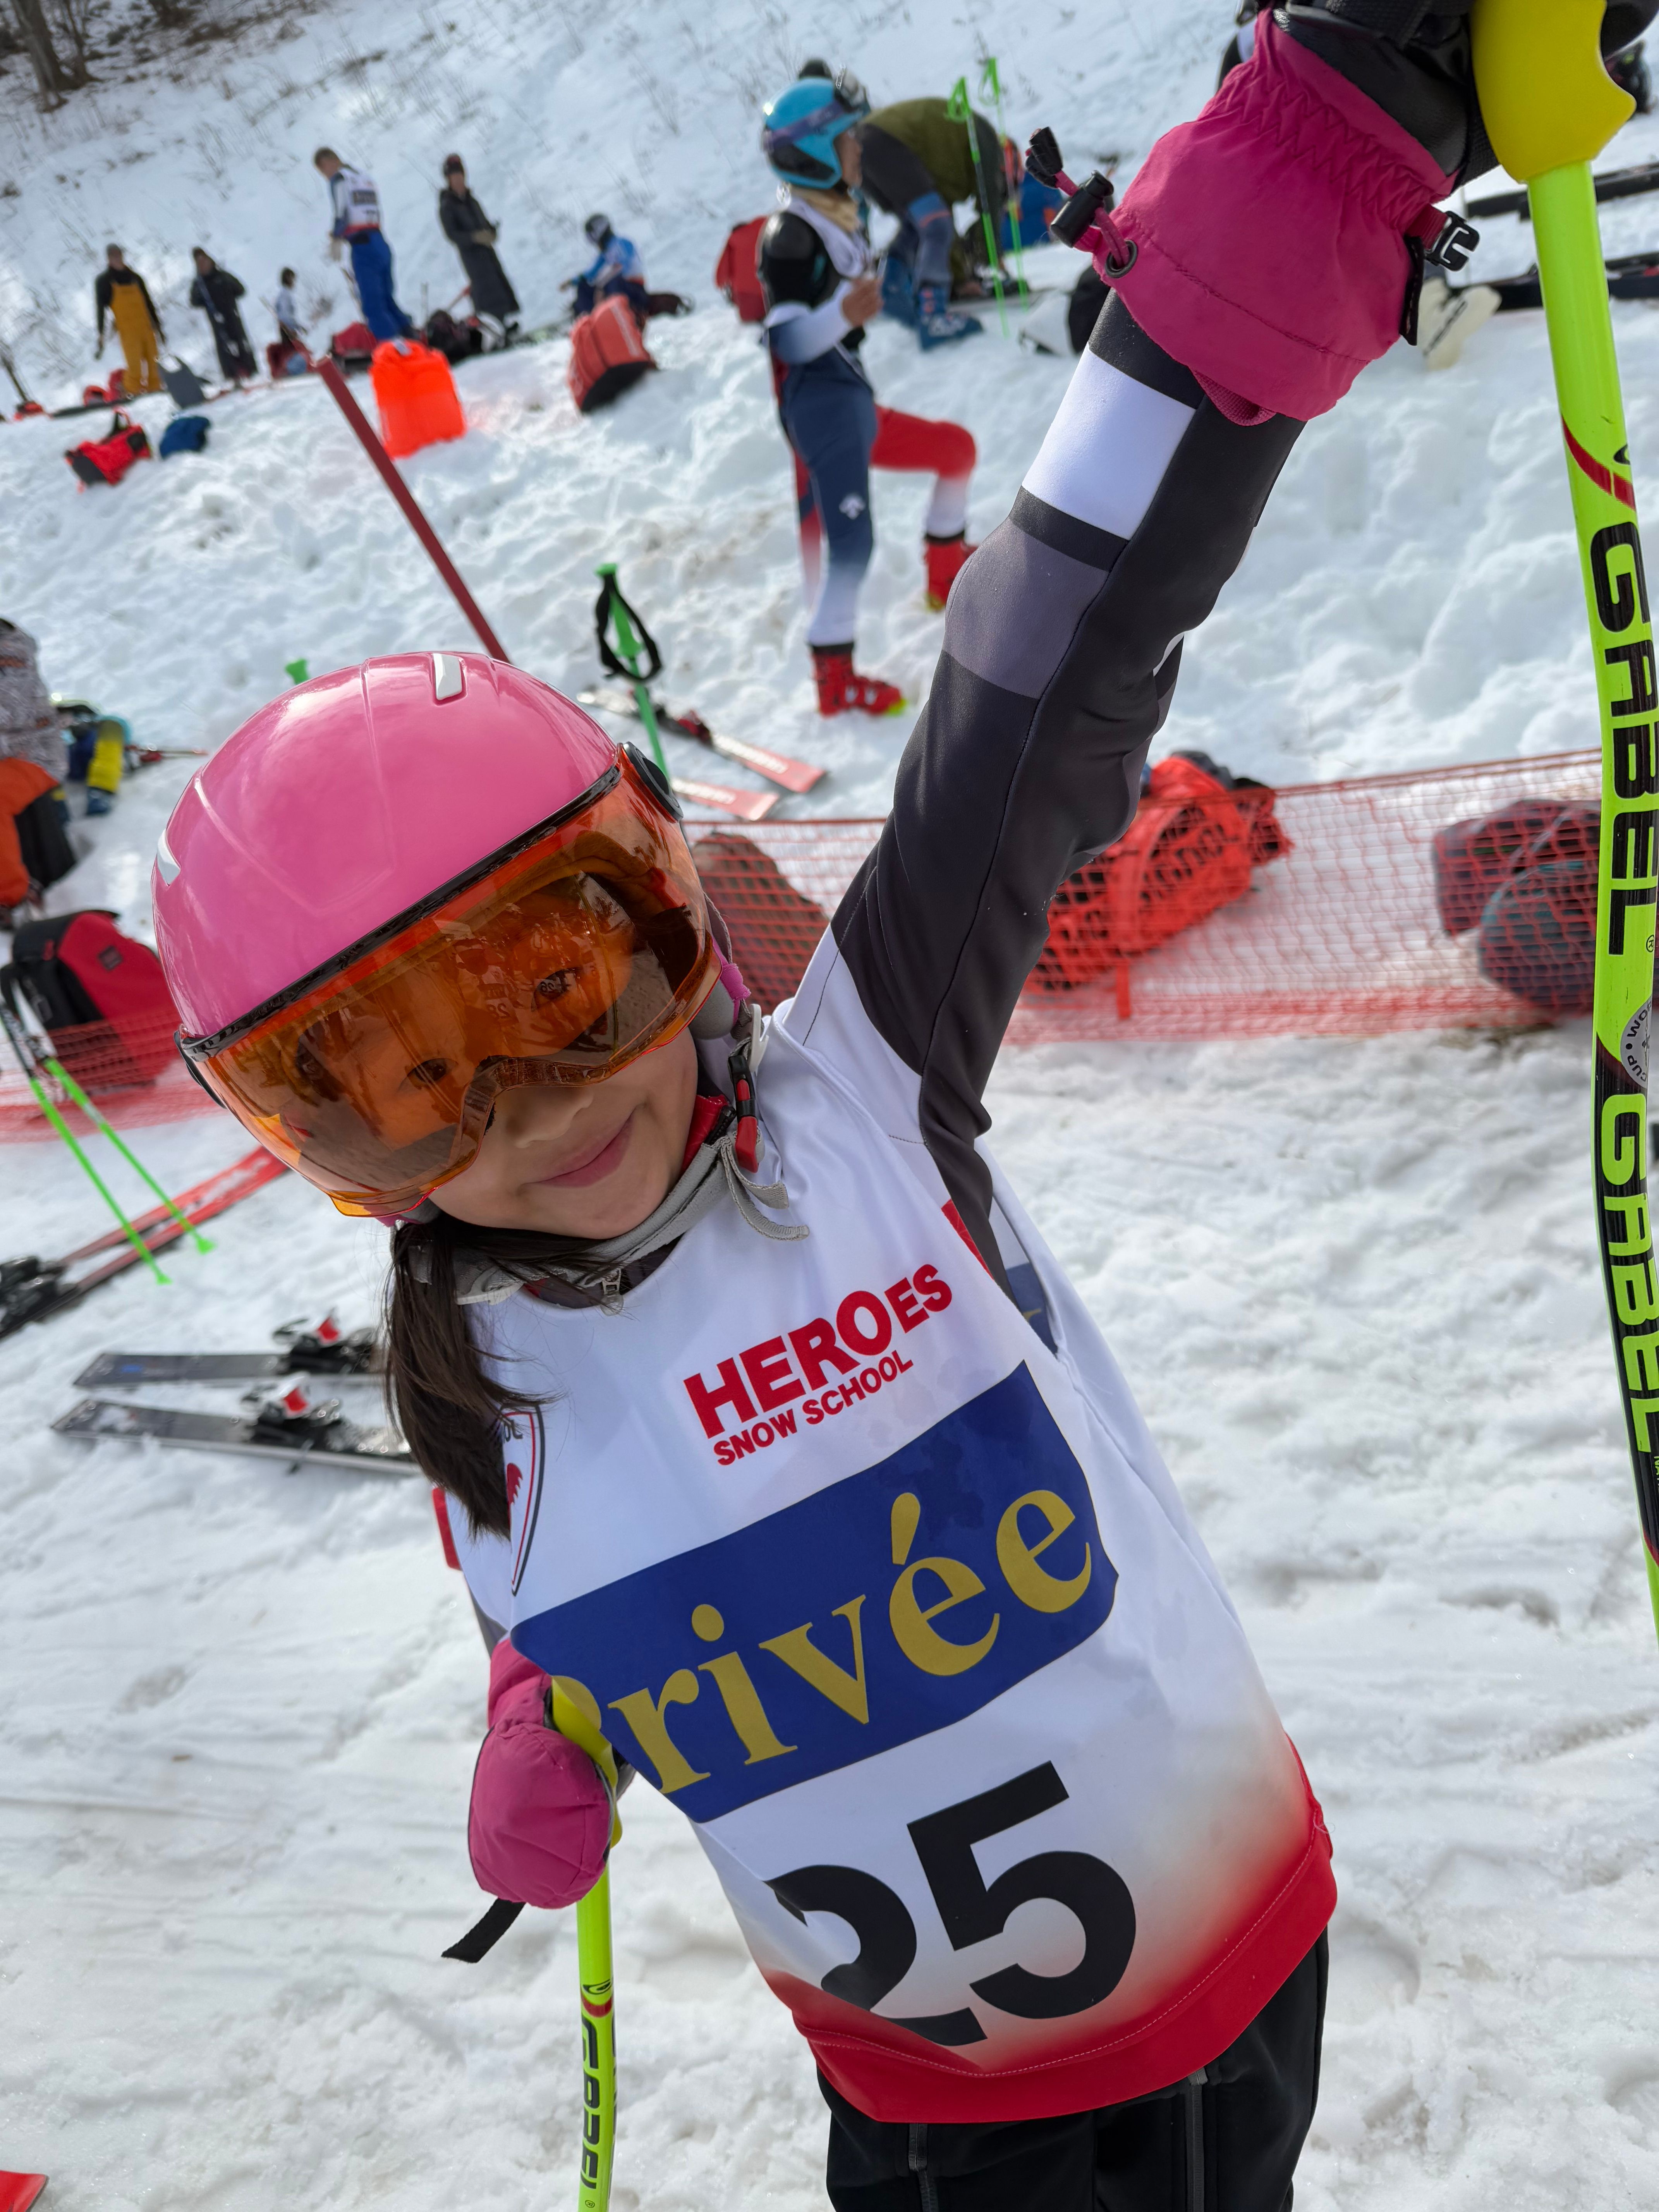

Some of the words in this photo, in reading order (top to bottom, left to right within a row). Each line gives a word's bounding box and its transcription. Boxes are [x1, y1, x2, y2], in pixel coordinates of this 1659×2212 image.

[1590, 522, 1659, 955] GABEL
[683, 1264, 953, 1439] HEROES
[713, 1408, 798, 1466] SNOW
[802, 1350, 914, 1425] SCHOOL
[1601, 1093, 1659, 1453] GABEL
[763, 1760, 1137, 2046] 25
